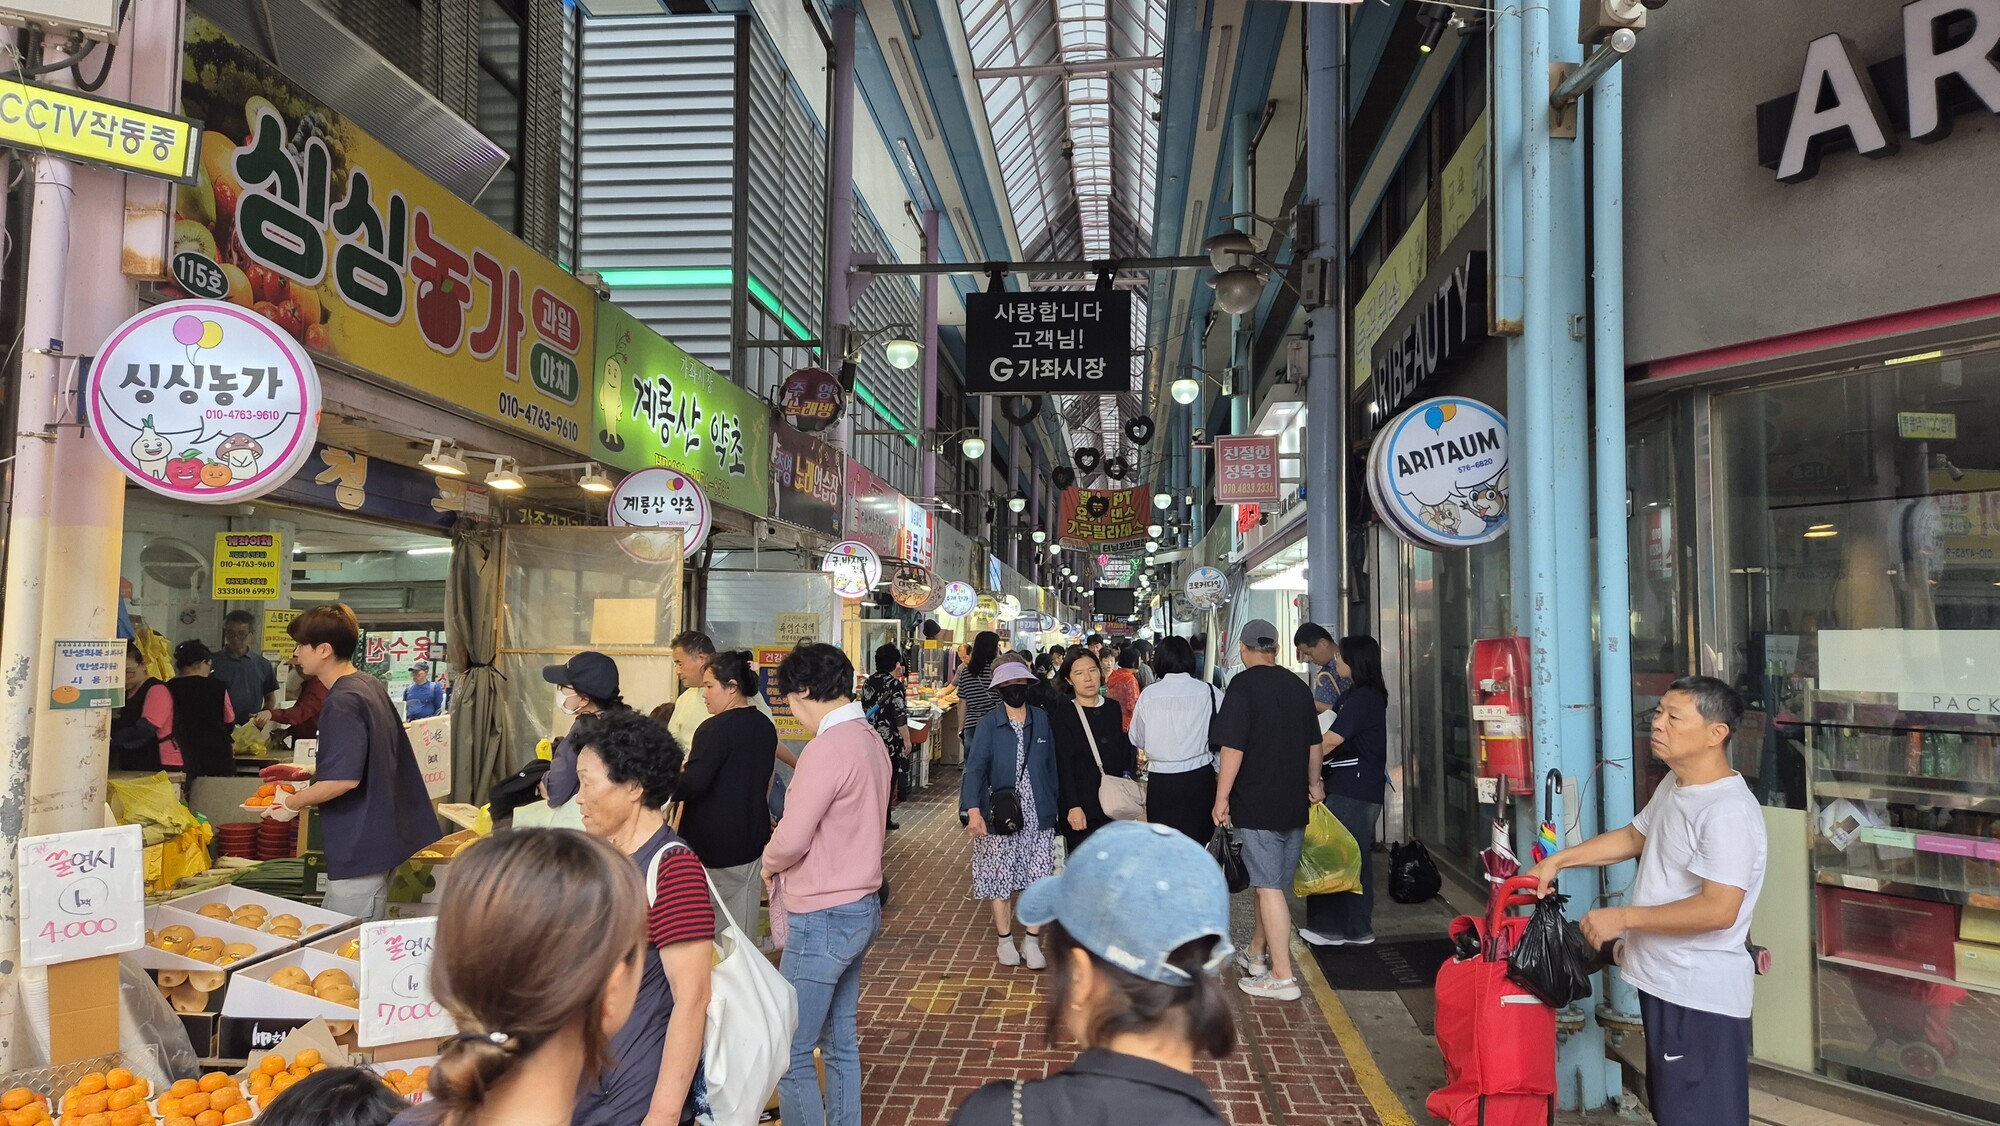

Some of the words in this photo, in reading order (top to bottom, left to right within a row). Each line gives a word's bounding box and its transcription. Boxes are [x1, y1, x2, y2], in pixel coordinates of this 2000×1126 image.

[232, 106, 527, 381] 싱싱농가
[178, 256, 223, 298] 115호
[541, 300, 573, 343] 과일
[994, 300, 1103, 323] 사랑합니다
[1011, 328, 1085, 350] 고객님!
[119, 363, 285, 406] 싱싱농가
[540, 361, 571, 397] 야채
[205, 408, 281, 422] 010-4763-9610
[498, 391, 578, 443] 010-4763-9610
[785, 400, 835, 418] 노래방
[632, 373, 701, 456] 계룡산
[709, 410, 747, 478] 약초
[1223, 445, 1271, 461] 친절한
[1396, 427, 1501, 478] ARITAUM
[1224, 464, 1272, 480] 정육점
[1457, 457, 1494, 474] 576-6820
[1222, 482, 1275, 495] 070.4833.2336
[622, 496, 666, 516] 계룡산
[670, 496, 696, 516] 약초
[1067, 519, 1145, 540] 기구필라테스
[219, 560, 275, 568] 010-4763-9610
[45, 846, 116, 878] 꿀연시
